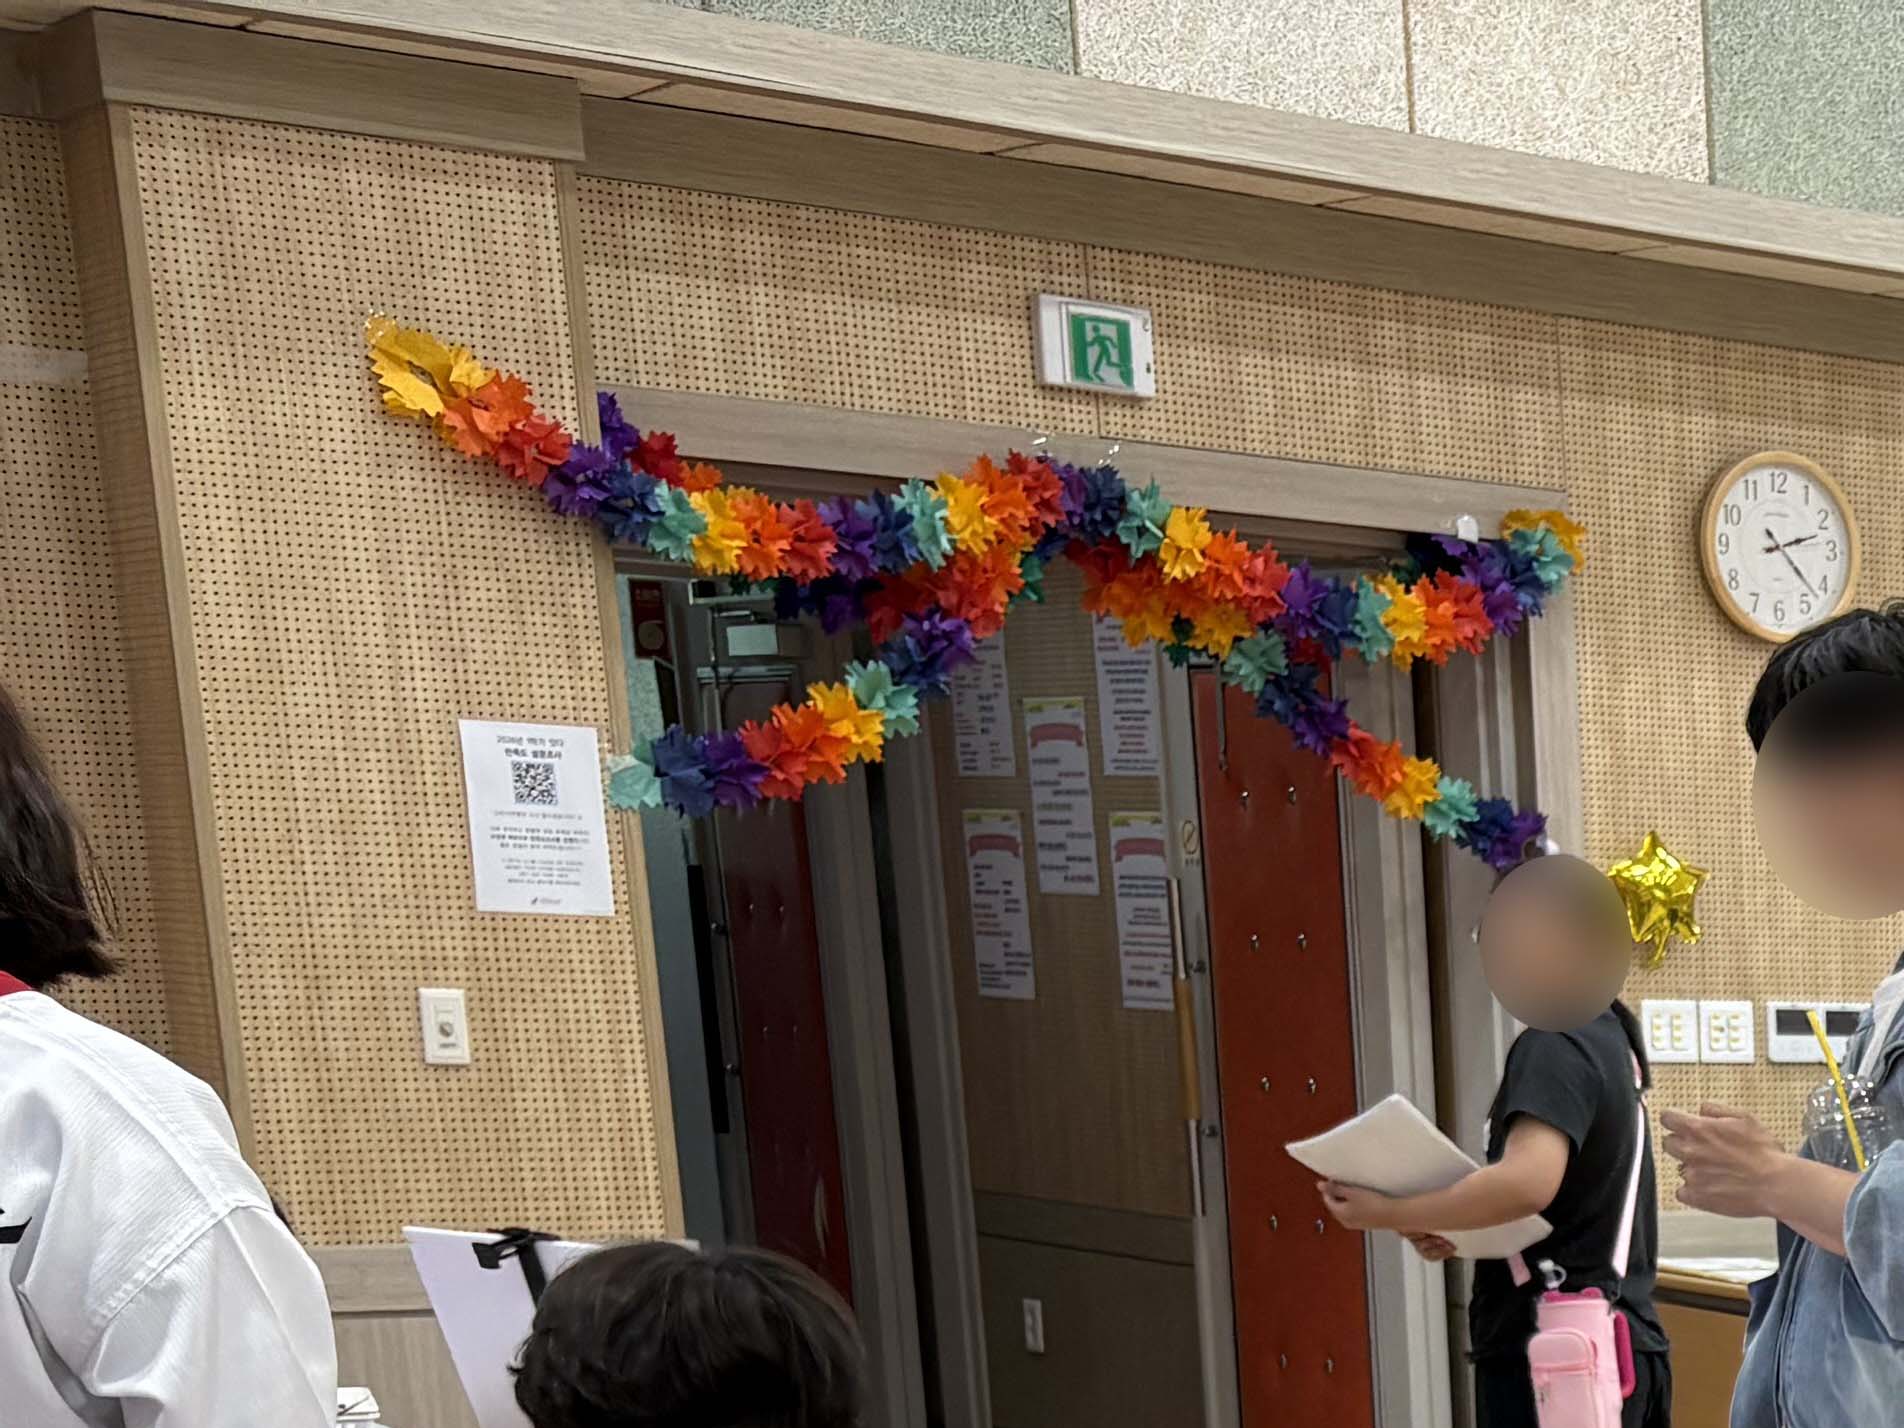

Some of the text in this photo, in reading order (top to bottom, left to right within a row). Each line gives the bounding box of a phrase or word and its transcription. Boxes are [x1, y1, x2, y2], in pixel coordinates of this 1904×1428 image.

[1743, 479, 1758, 501] 11
[1770, 472, 1788, 494] 12
[1804, 485, 1809, 506] 1
[1723, 503, 1742, 526] 10
[1817, 508, 1829, 531] 2
[1718, 533, 1730, 555] 9
[1825, 540, 1838, 562] 3
[1728, 568, 1739, 591] 8
[1818, 575, 1828, 595] 4
[1749, 592, 1760, 613] 7
[1774, 600, 1785, 622] 6
[1800, 593, 1811, 615] 5
